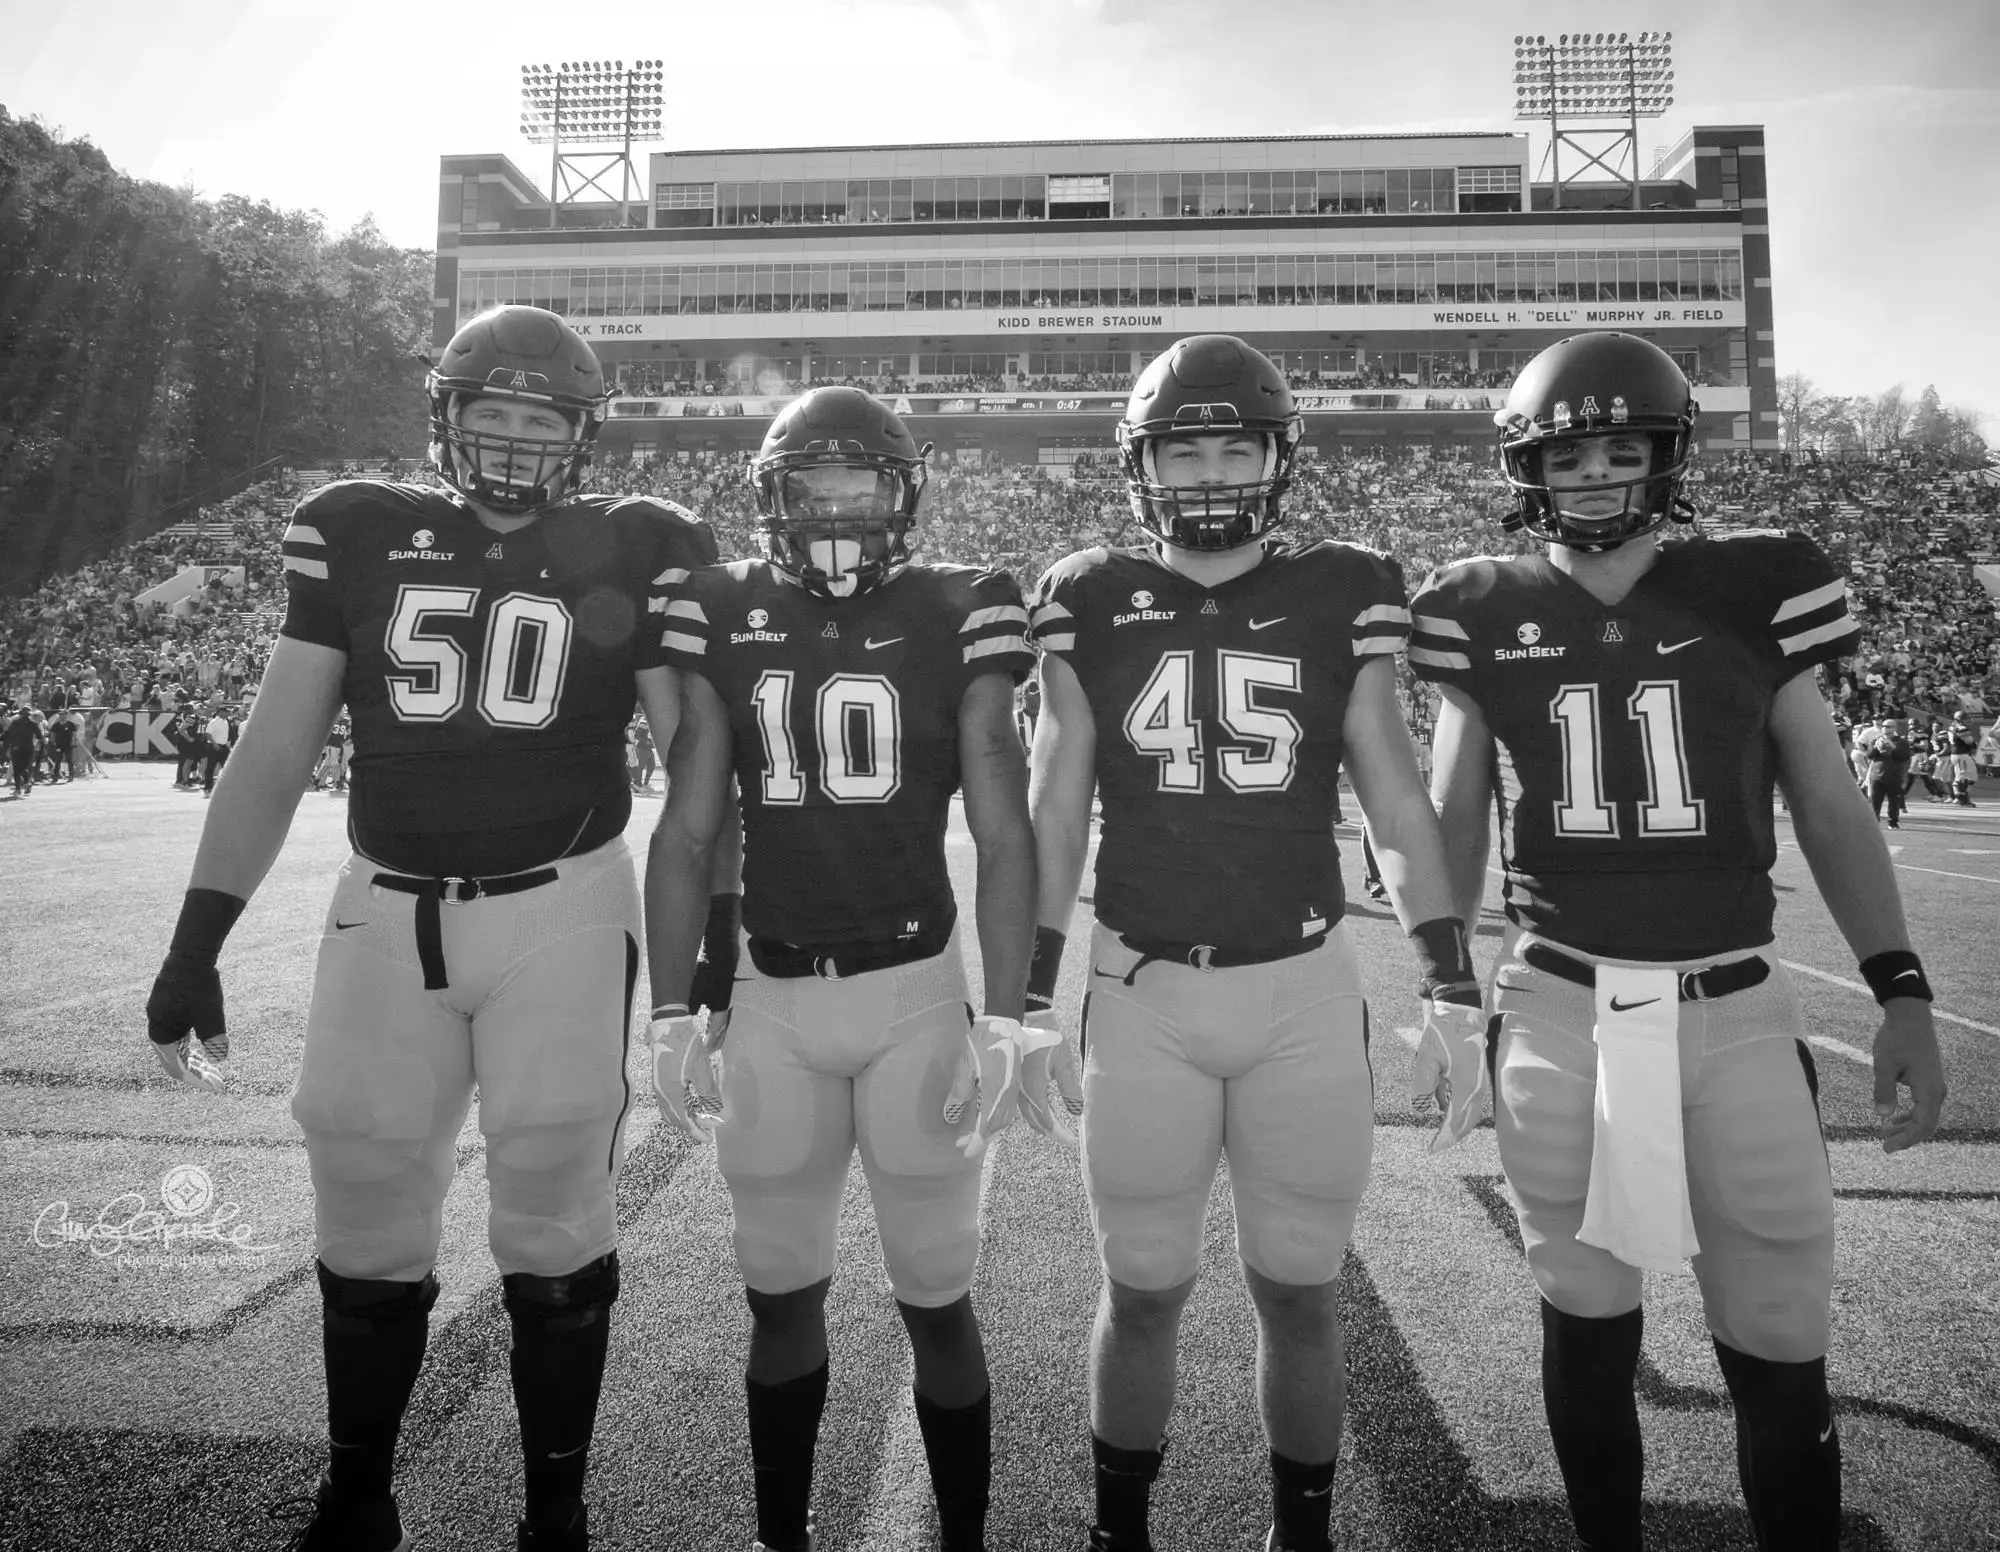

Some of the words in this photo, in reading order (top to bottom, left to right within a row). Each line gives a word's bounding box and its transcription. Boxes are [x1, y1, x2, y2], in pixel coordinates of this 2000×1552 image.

[998, 317, 1031, 328] KIDD
[1038, 317, 1094, 327] BREWER
[1102, 316, 1162, 326] STADIUM
[1433, 312, 1500, 323] WENDELL
[1507, 312, 1521, 322] H.
[1528, 310, 1578, 322] "DELL"
[1586, 311, 1645, 321] MURPHY
[1654, 310, 1675, 321] JR.
[1683, 310, 1724, 320] FIELD
[600, 324, 643, 335] TRACK
[1056, 399, 1082, 410] 0:47
[1296, 397, 1319, 409] APP
[1321, 397, 1352, 409] STATE
[1580, 396, 1600, 415] A
[388, 550, 419, 561] SUN
[420, 550, 455, 561] BELT
[485, 542, 503, 560] A
[1200, 599, 1219, 614] A
[1113, 612, 1140, 627] SUN
[1141, 609, 1176, 621] BELT
[730, 632, 754, 645] SUN
[754, 630, 788, 642] BELT
[821, 621, 839, 639] A
[1602, 621, 1623, 643] A
[384, 583, 573, 730] 50
[1494, 648, 1527, 661] SUN
[1528, 646, 1566, 658] BELT
[1122, 648, 1303, 795] 45
[750, 669, 902, 807] 10
[1548, 679, 1707, 840] 11
[1309, 906, 1318, 918] L
[906, 921, 919, 933] M
